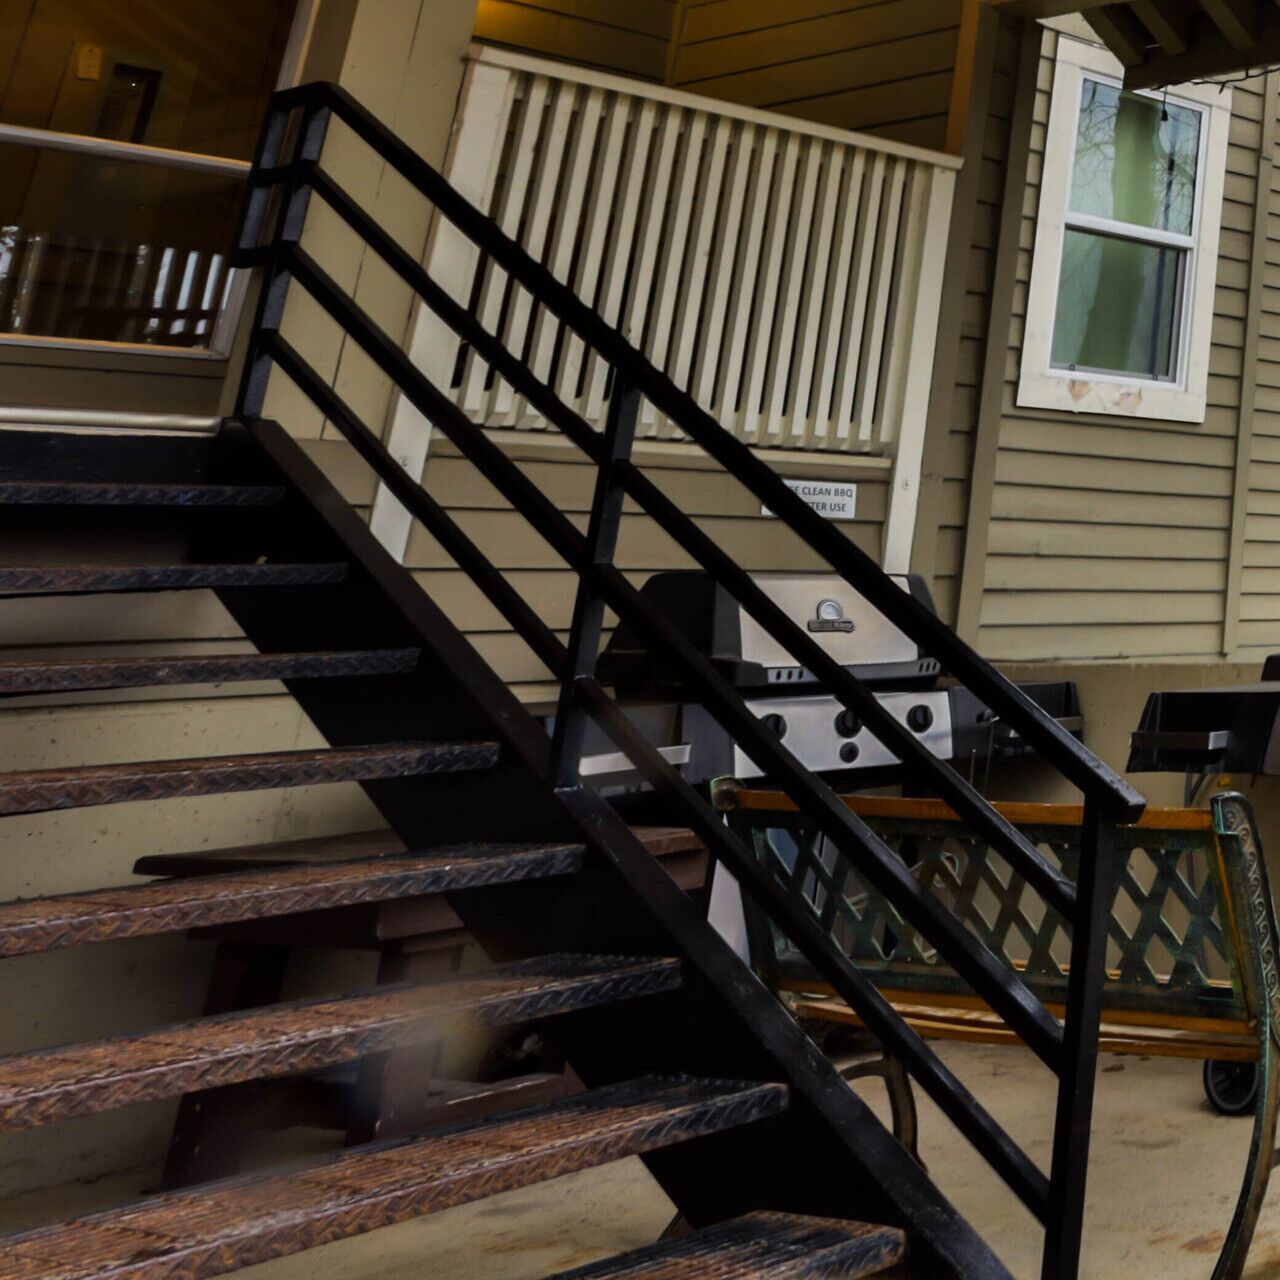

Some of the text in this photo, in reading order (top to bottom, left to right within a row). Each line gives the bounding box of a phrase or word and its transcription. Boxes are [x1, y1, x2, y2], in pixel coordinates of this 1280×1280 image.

[802, 486, 831, 496] CLEAN
[834, 488, 853, 498] BBQ
[830, 503, 847, 512] USE
